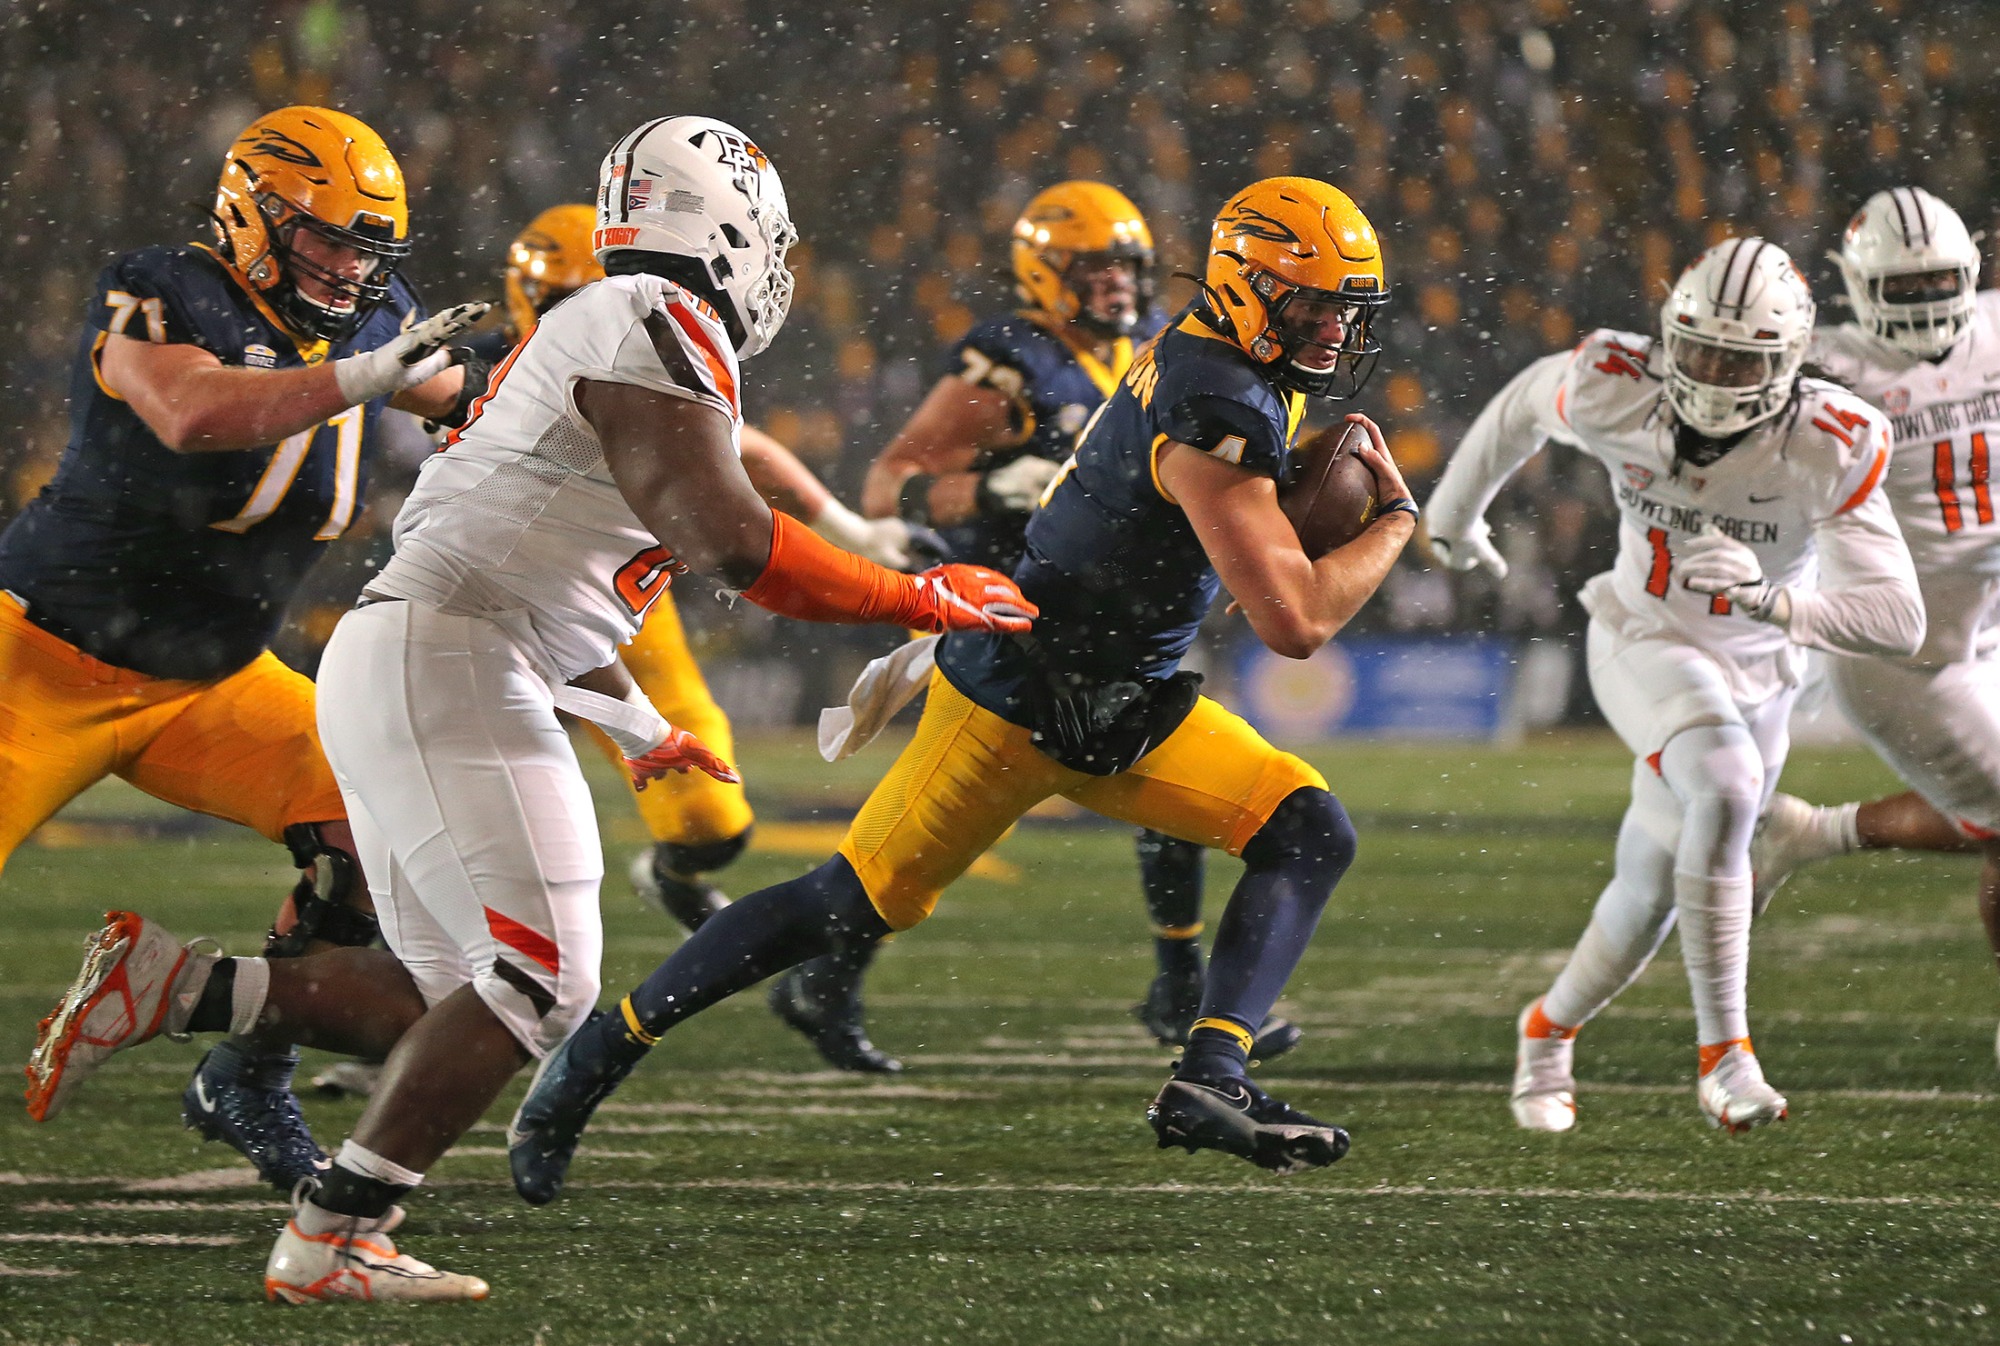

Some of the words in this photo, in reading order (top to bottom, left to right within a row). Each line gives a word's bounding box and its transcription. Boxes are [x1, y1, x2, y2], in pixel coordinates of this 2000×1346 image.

[105, 289, 167, 344] 71
[1811, 402, 1870, 448] 14
[1892, 402, 1960, 442] OWLING
[1963, 391, 2000, 424] GREE
[1933, 431, 1994, 533] 11
